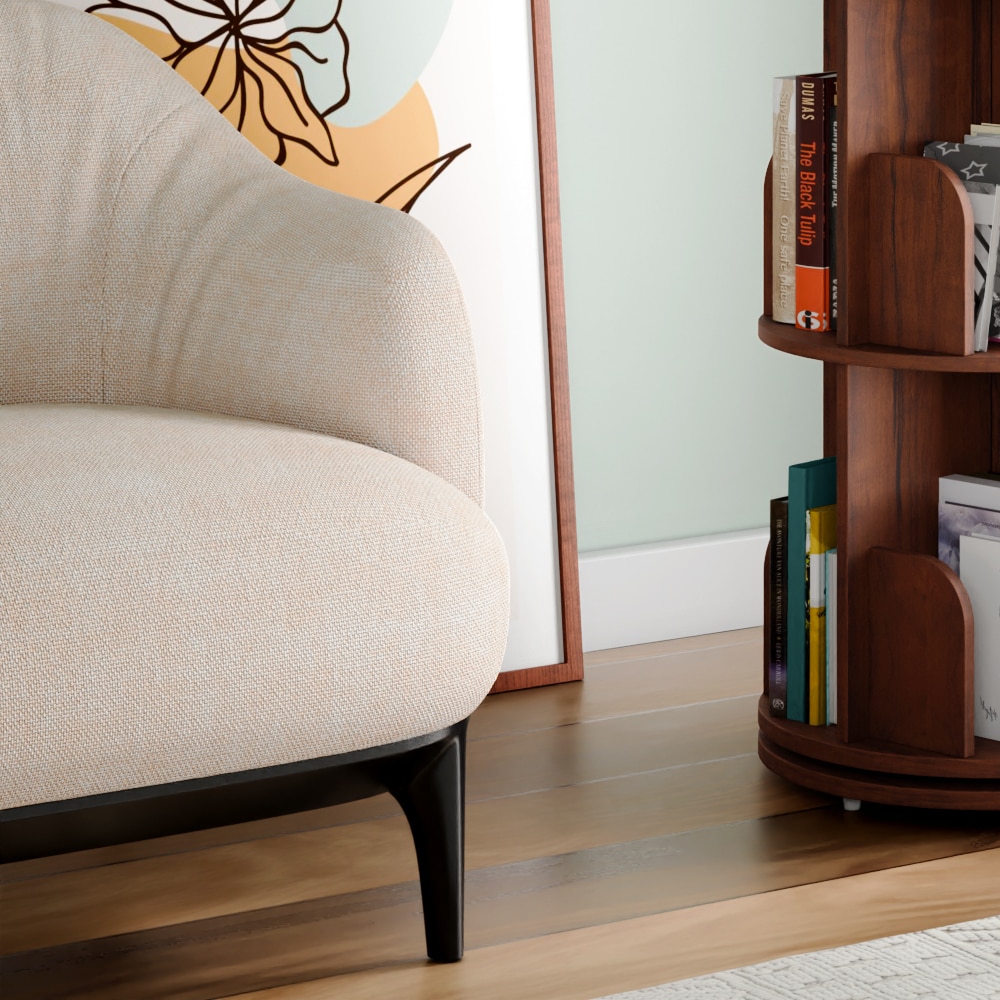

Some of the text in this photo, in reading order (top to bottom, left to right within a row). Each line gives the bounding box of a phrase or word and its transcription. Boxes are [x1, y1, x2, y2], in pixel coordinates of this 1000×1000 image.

[779, 92, 790, 202] Save Planet Earth!
[801, 81, 815, 121] DUMAS
[797, 141, 816, 247] The Black Tulip
[778, 215, 791, 309] One safe place
